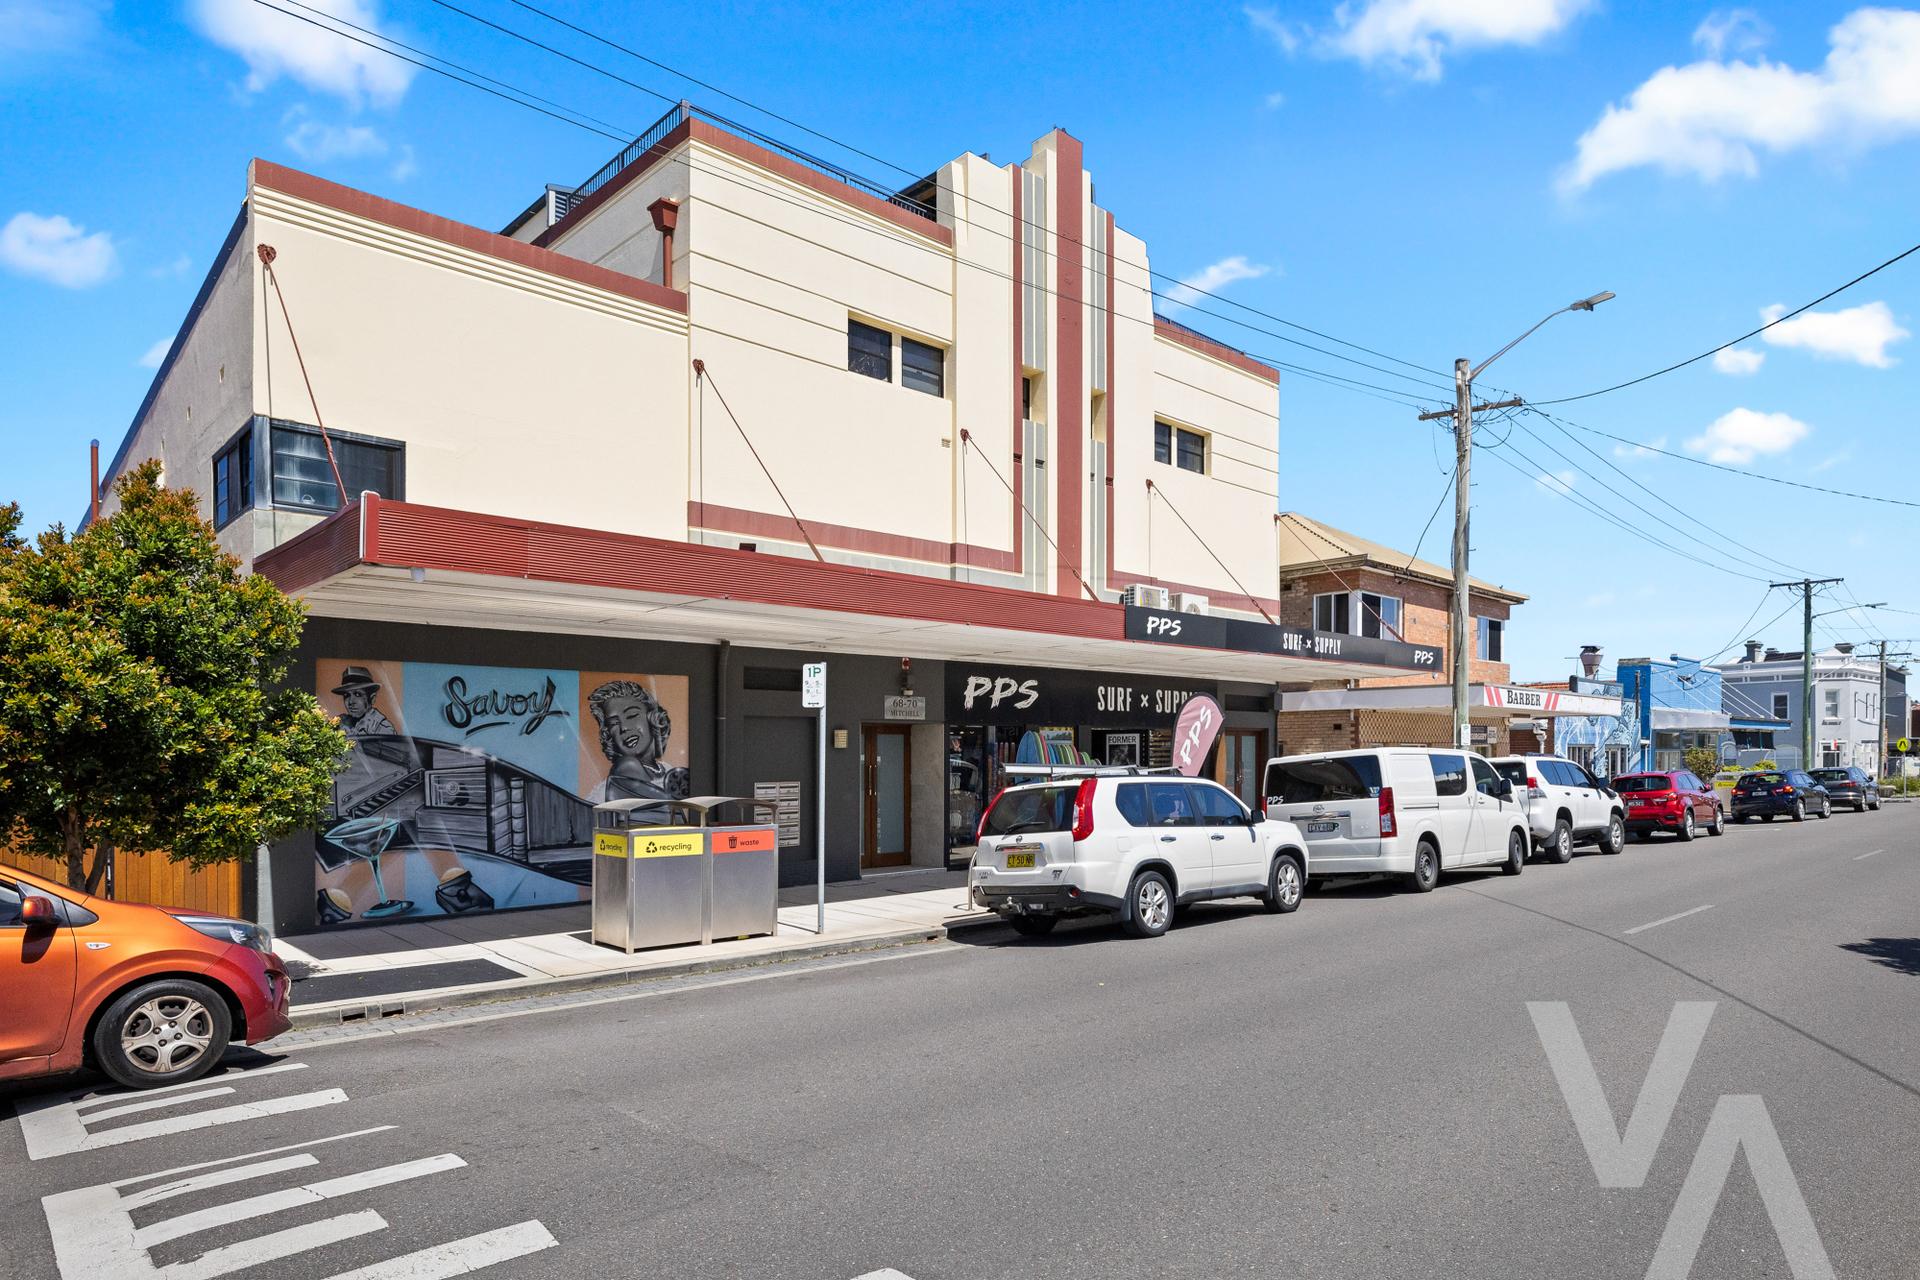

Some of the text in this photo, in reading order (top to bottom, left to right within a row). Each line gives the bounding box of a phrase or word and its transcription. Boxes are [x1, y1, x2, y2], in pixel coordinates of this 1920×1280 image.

[1146, 615, 1182, 636] PPS
[1283, 632, 1303, 651] SURF
[1314, 636, 1342, 656] SUPPLY
[1414, 650, 1434, 665] PPS
[807, 667, 822, 678] 1P
[963, 674, 1039, 711] PPS
[1097, 685, 1132, 712] SURF
[1506, 689, 1541, 707] BARBER
[444, 676, 570, 735] Savoy
[892, 698, 918, 709] 68-70
[1108, 736, 1137, 744] FORMER
[1180, 705, 1212, 766] PPS
[1267, 795, 1285, 805] PPS
[659, 842, 692, 852] recycling
[739, 838, 760, 847] waste
